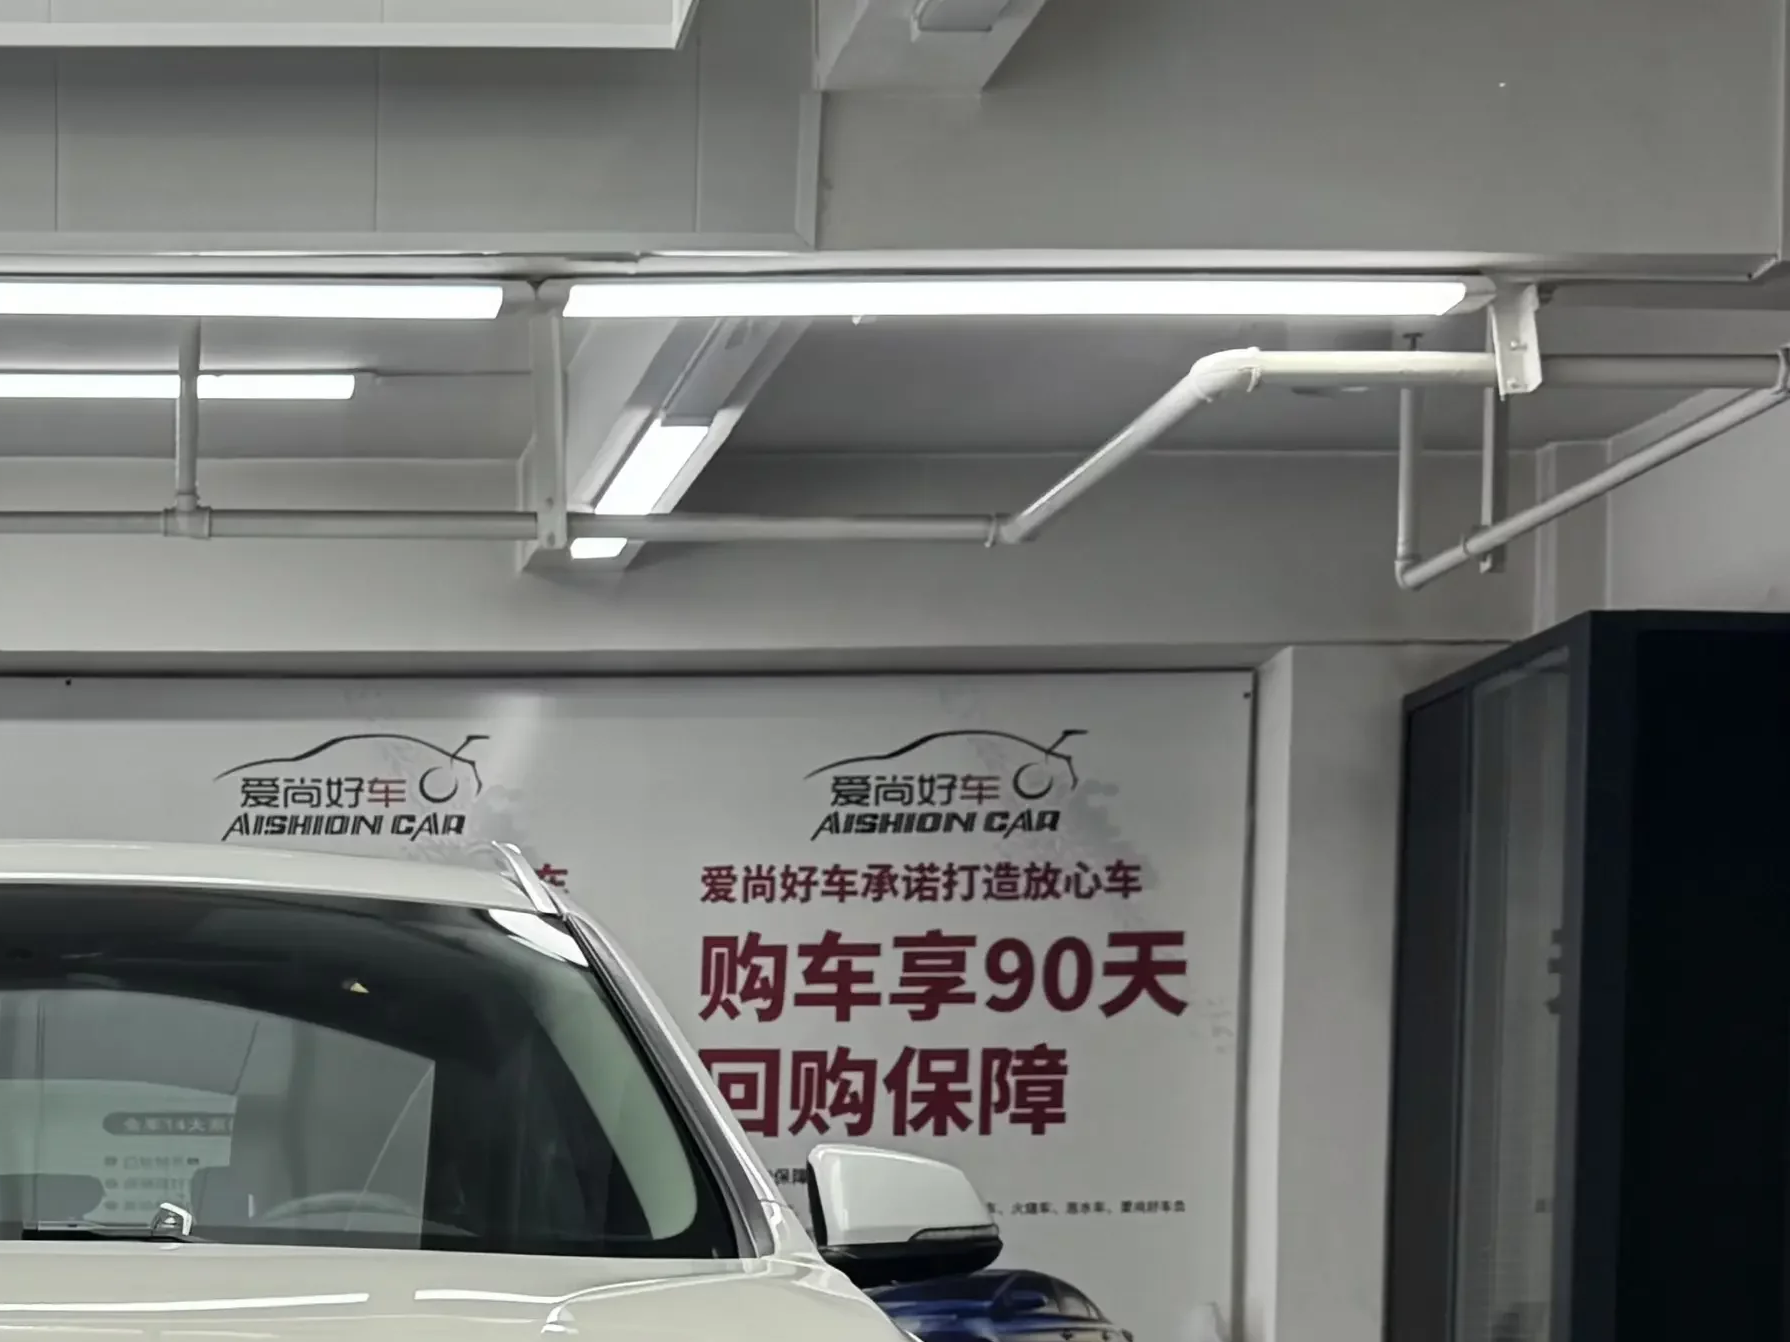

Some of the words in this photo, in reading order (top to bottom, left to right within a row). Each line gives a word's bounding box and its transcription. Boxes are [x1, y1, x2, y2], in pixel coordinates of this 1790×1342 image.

[240, 776, 407, 809] 爱尚好车
[831, 774, 999, 807] 爱尚好车
[220, 811, 385, 842] AISHION
[391, 811, 466, 843] CAR
[810, 809, 977, 842] AISHION
[982, 808, 1061, 840] CAR
[700, 859, 1143, 903] 爱尚好车承诺打造放心车
[698, 929, 1188, 1023] 购车享90天
[697, 1043, 1068, 1137] 回购保障
